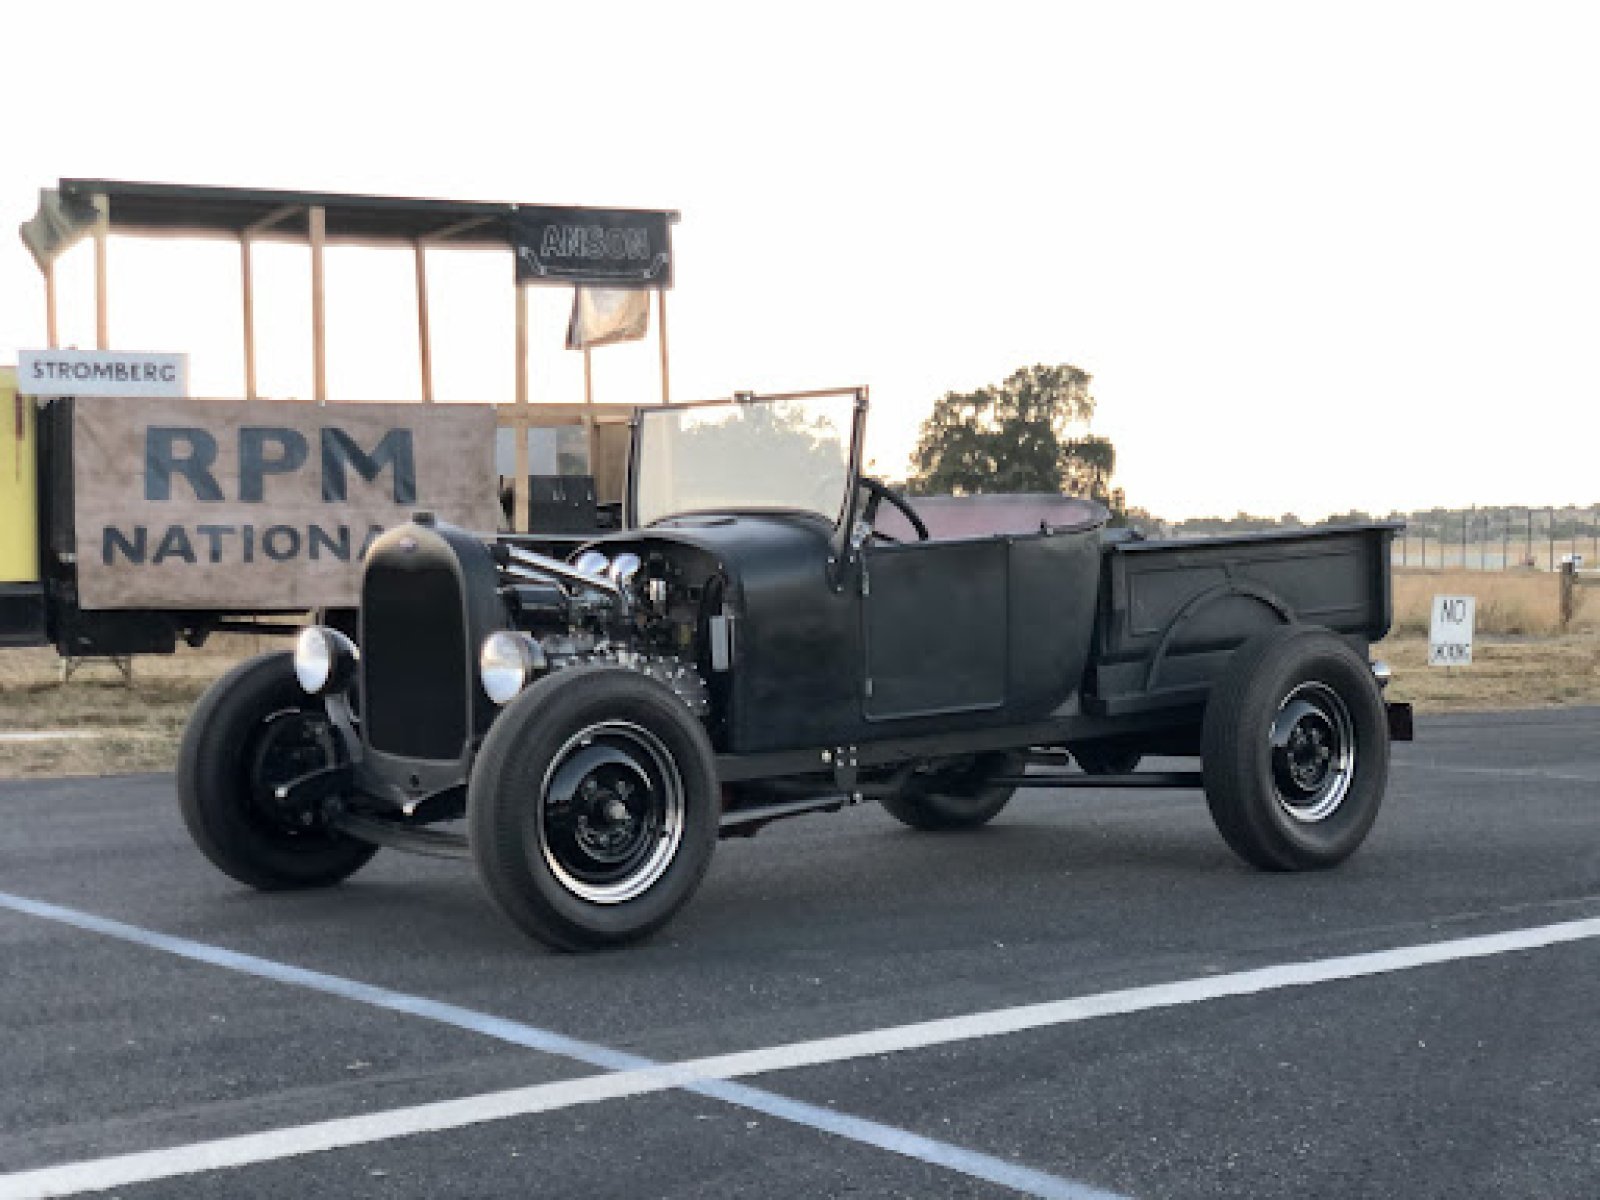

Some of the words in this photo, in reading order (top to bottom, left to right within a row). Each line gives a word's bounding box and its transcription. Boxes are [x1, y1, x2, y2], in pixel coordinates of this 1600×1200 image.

[32, 359, 176, 382] STROMBERG
[145, 425, 416, 504] RPM
[1441, 600, 1466, 624] NO
